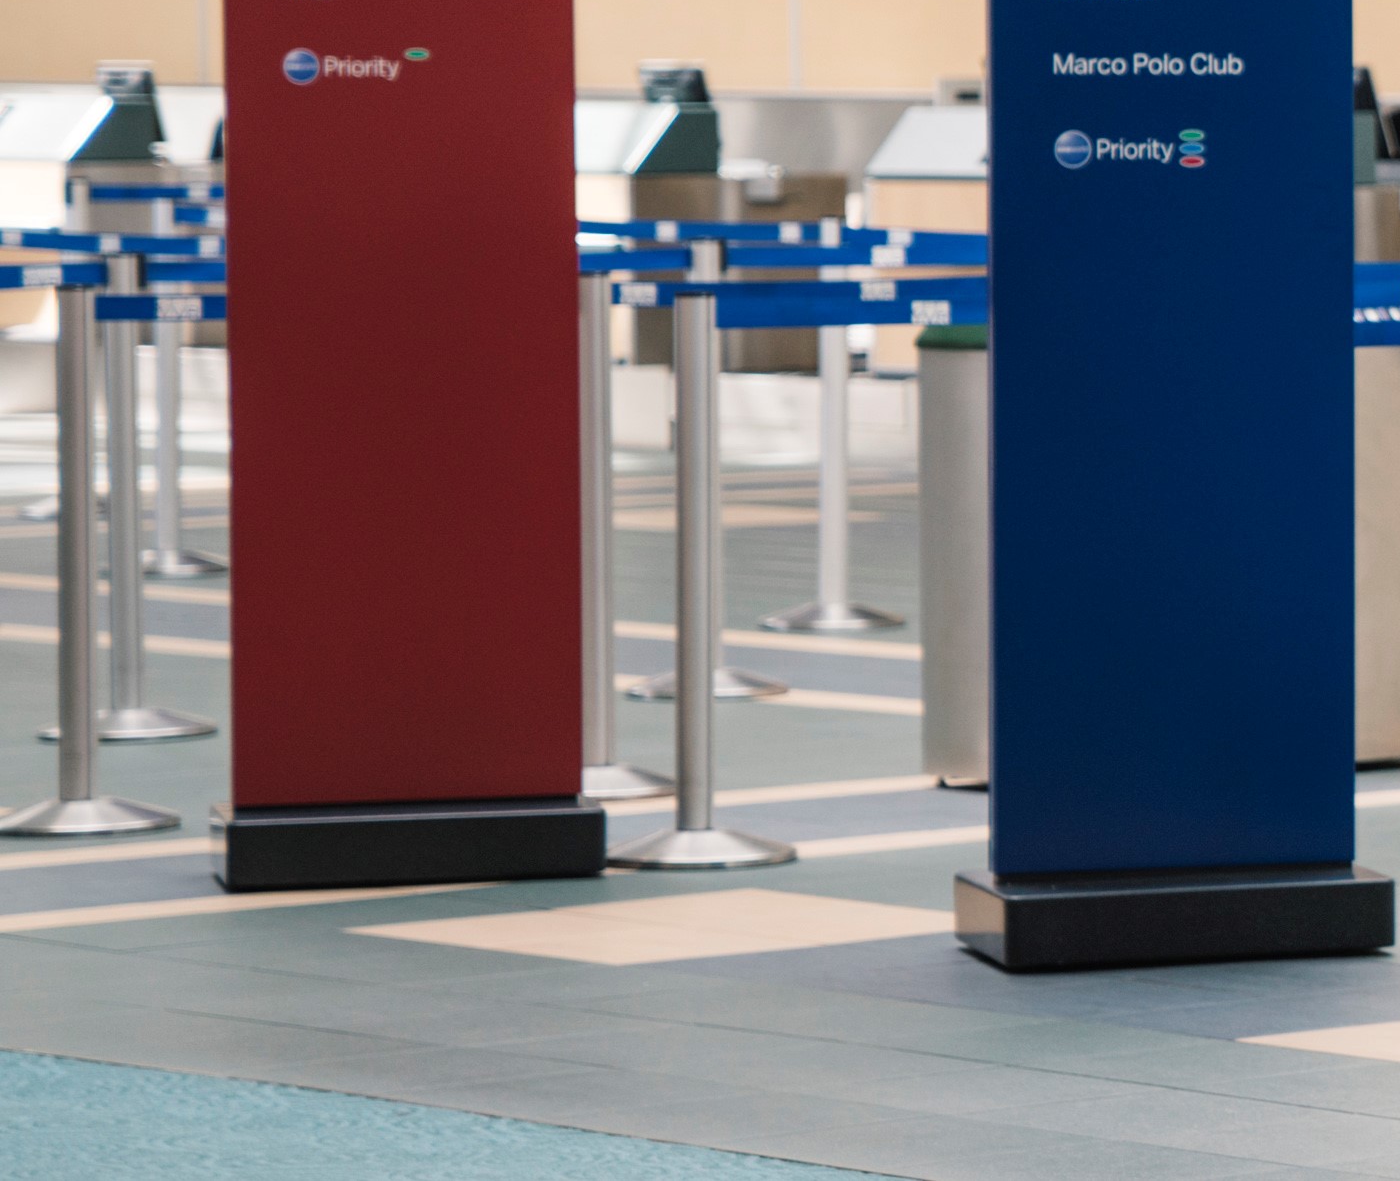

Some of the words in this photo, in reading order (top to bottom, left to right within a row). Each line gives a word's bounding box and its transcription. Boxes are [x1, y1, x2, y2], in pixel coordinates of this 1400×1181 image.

[324, 55, 399, 81] Priority
[1053, 52, 1127, 75] Marco
[1133, 52, 1184, 75] Polo
[1190, 52, 1244, 75] Club
[1096, 137, 1174, 164] Priority
